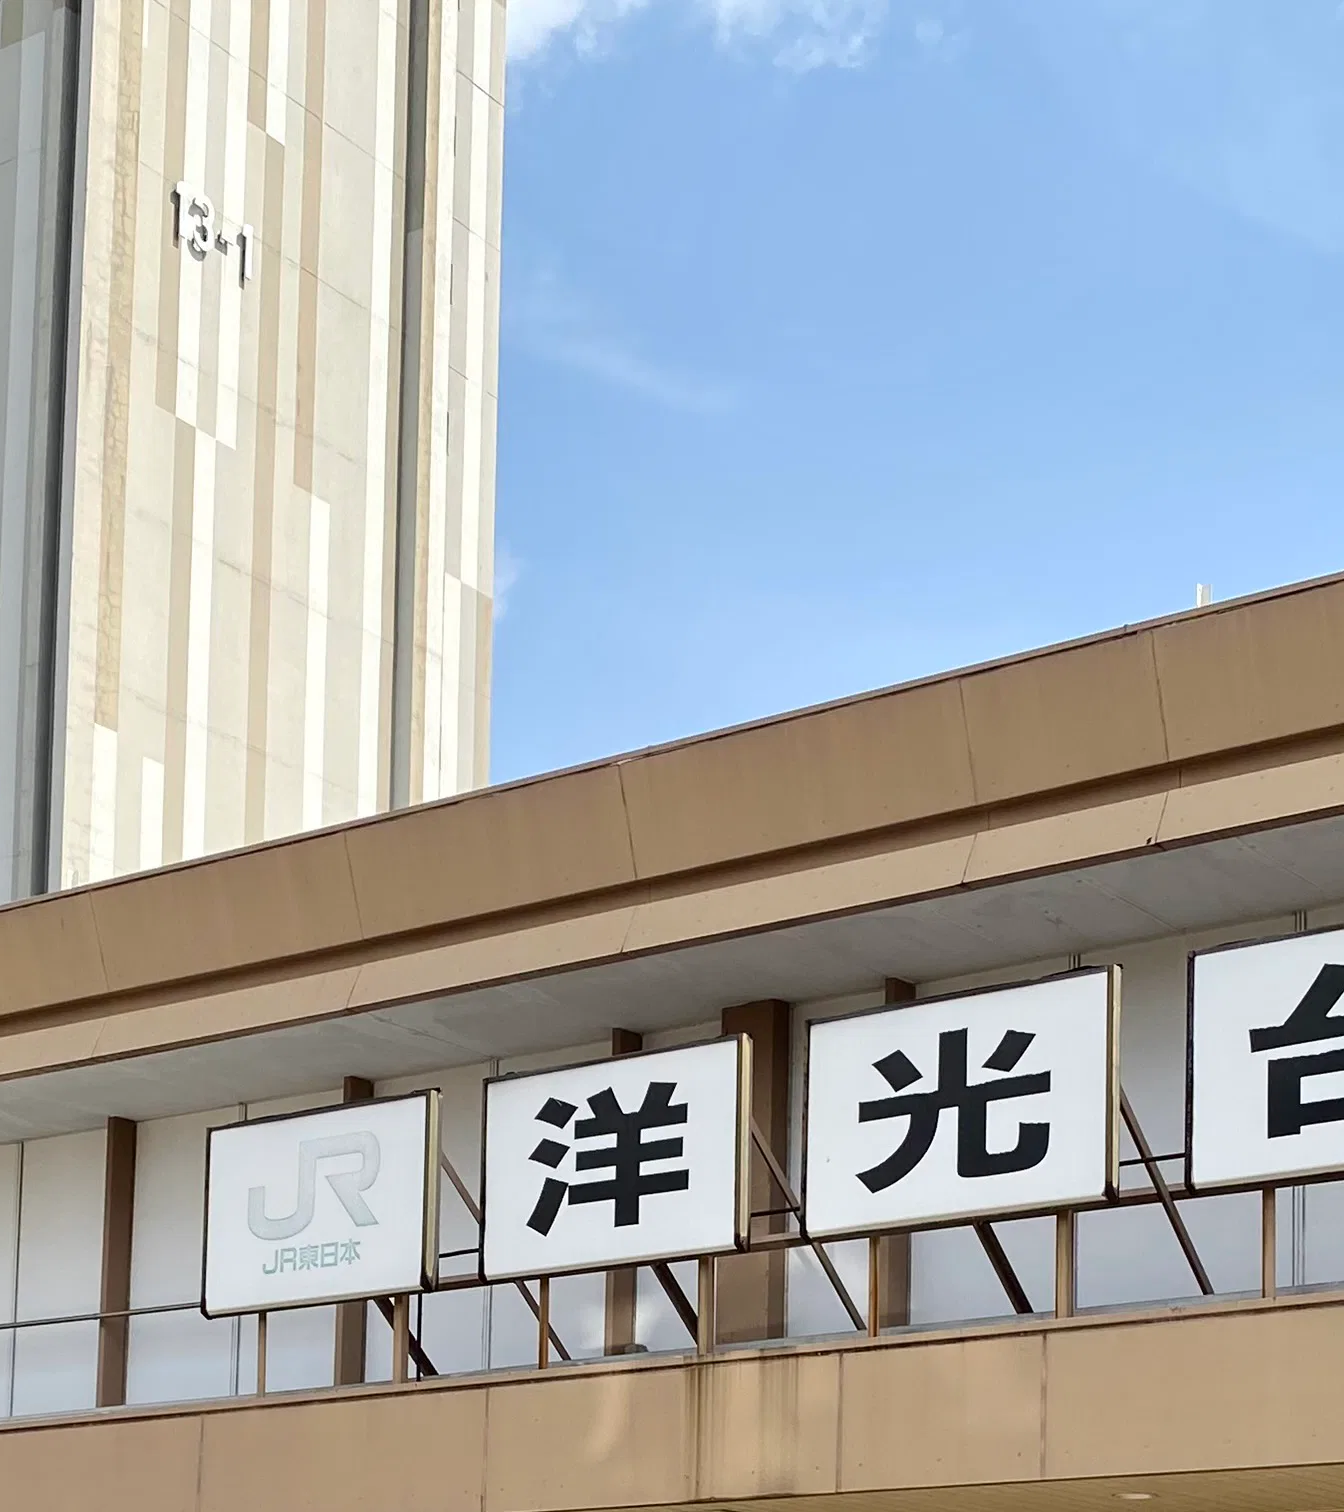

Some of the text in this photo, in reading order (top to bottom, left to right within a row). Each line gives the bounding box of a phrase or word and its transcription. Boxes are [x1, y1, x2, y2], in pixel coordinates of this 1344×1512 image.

[170, 180, 254, 290] 13-1
[248, 1130, 382, 1241] JR
[262, 1238, 361, 1275] JR東日本
